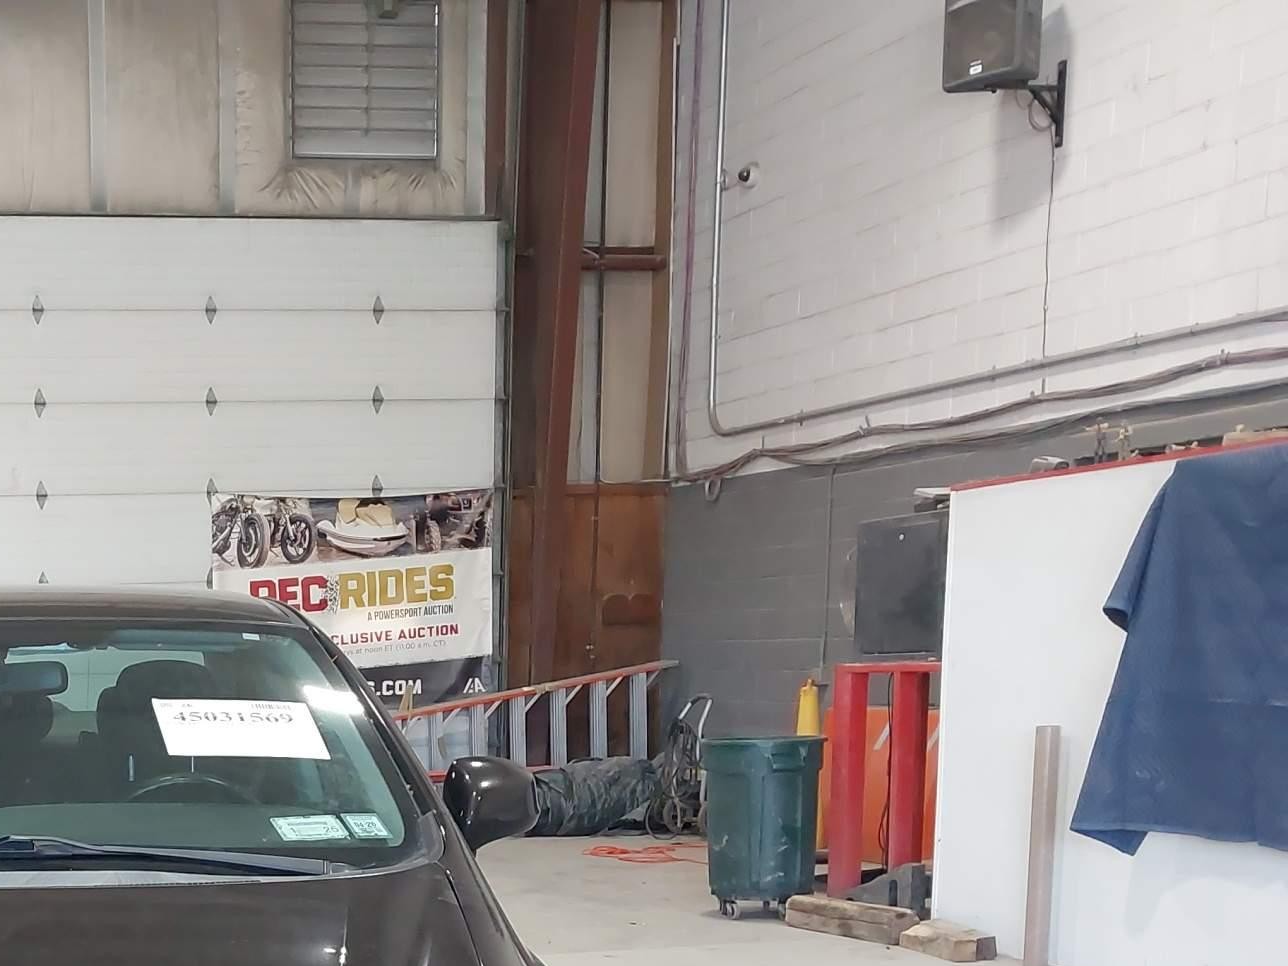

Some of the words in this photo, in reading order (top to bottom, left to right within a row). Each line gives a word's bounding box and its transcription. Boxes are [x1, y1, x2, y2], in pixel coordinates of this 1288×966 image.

[339, 564, 454, 609] RIDES
[368, 612, 372, 621] A
[374, 607, 421, 620] POWERSPORT
[423, 604, 453, 616] AUCTION
[398, 624, 458, 640] AUCTION
[173, 711, 294, 723] 45031569
